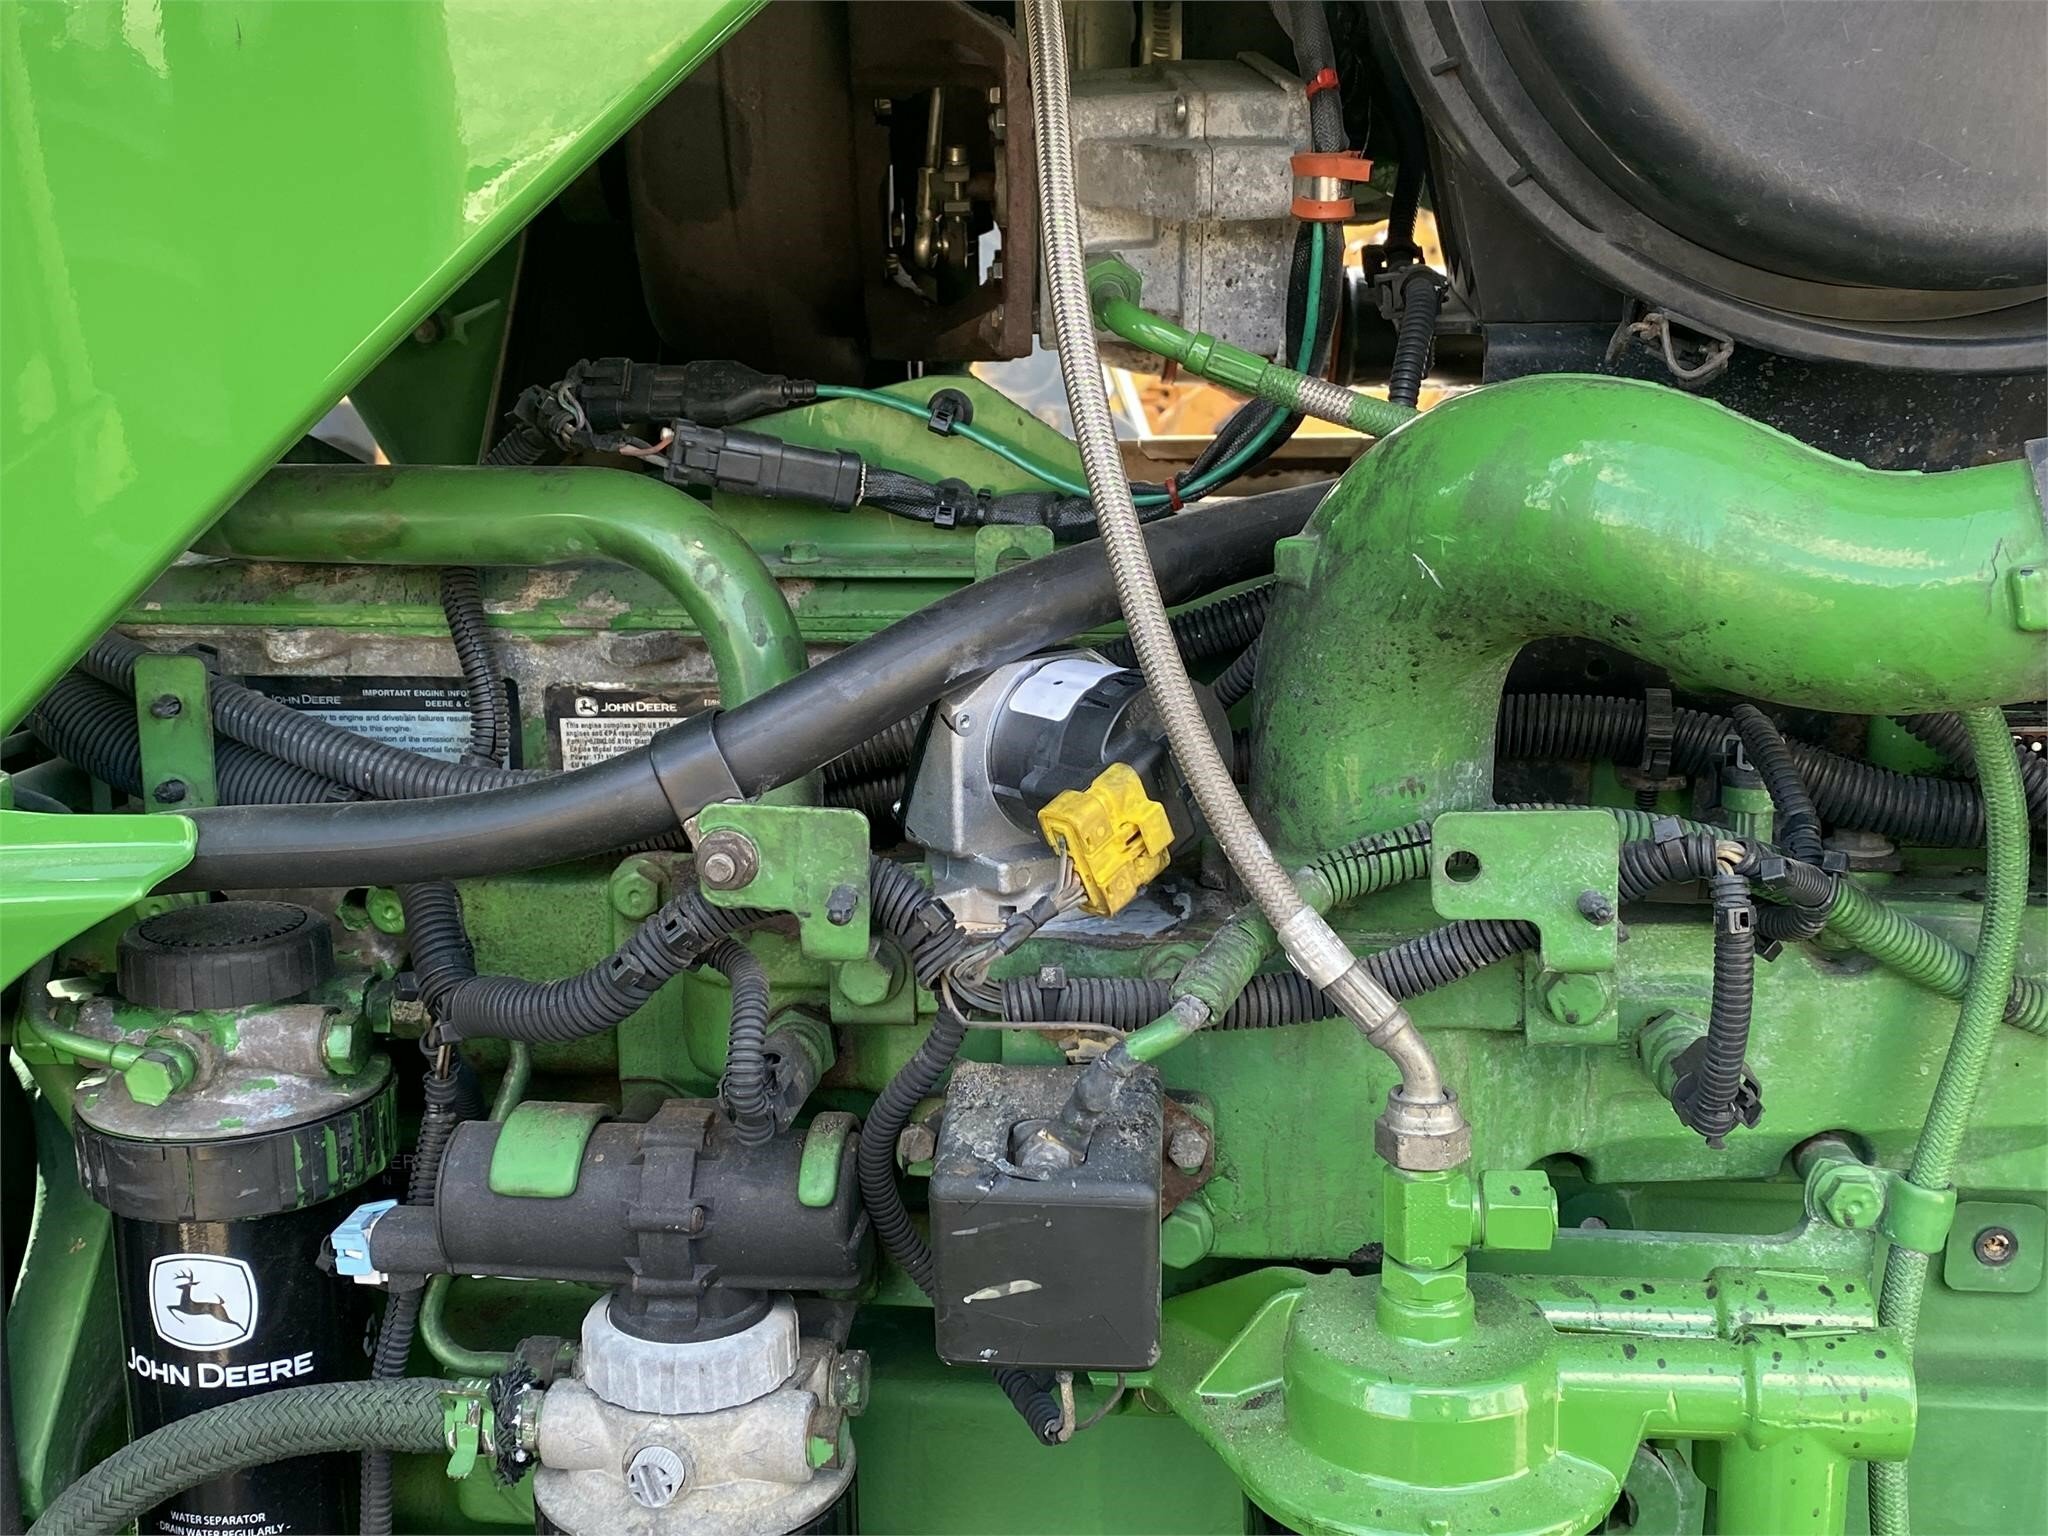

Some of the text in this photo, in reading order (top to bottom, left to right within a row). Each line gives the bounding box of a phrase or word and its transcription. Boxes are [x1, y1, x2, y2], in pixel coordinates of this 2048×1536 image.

[362, 689, 411, 697] IMPORTANT
[301, 694, 341, 705] DEERE
[601, 701, 677, 712] JOHN DEERE
[338, 714, 363, 722] engine
[127, 1346, 314, 1388] JOHN DEERE
[170, 1510, 266, 1526] WATER SEPARATOR
[159, 1520, 185, 1535] DRAIN
[185, 1527, 219, 1536] WATER
[221, 1522, 284, 1536] REGULARLY
